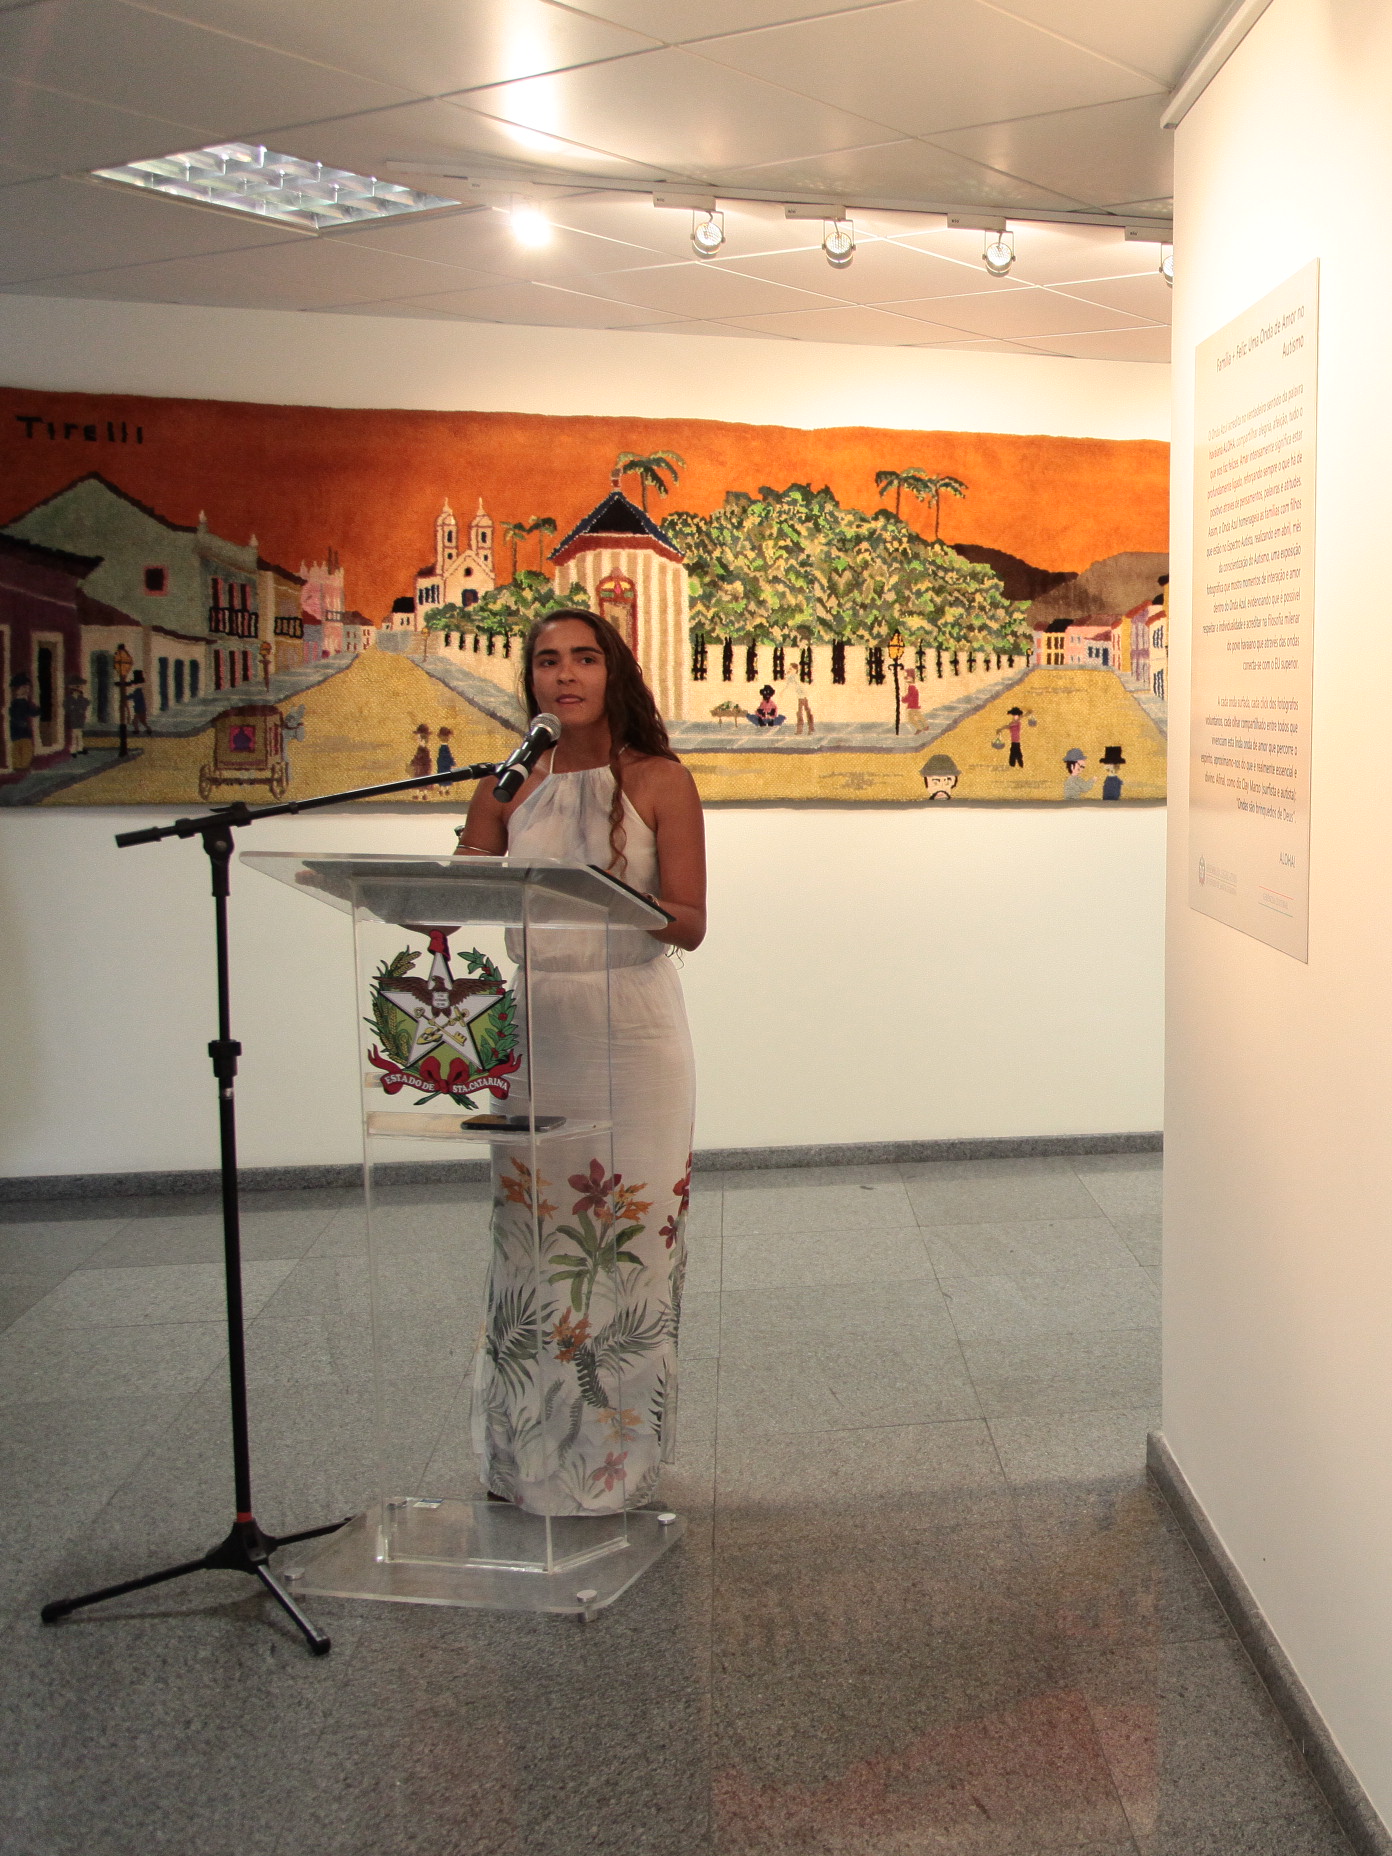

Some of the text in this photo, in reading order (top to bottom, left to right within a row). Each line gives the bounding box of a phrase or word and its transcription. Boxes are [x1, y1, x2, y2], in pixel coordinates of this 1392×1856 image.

[1260, 324, 1273, 345] Onda
[1282, 310, 1296, 331] Amor
[1282, 334, 1304, 359] Autismo
[1288, 383, 1303, 403] palavra
[16, 416, 144, 445] Tirelli
[1292, 428, 1303, 444] estar
[1282, 458, 1290, 473] que
[1280, 503, 1289, 515] com
[1290, 497, 1302, 512] filhos
[1271, 550, 1280, 562] uma
[1280, 542, 1301, 561] exposição
[1290, 568, 1301, 580] amor
[1287, 634, 1299, 647] ondas
[1278, 719, 1289, 732] todos
[1290, 723, 1298, 735] que
[384, 1073, 421, 1088] ESTADO
[421, 1083, 436, 1092] DE
